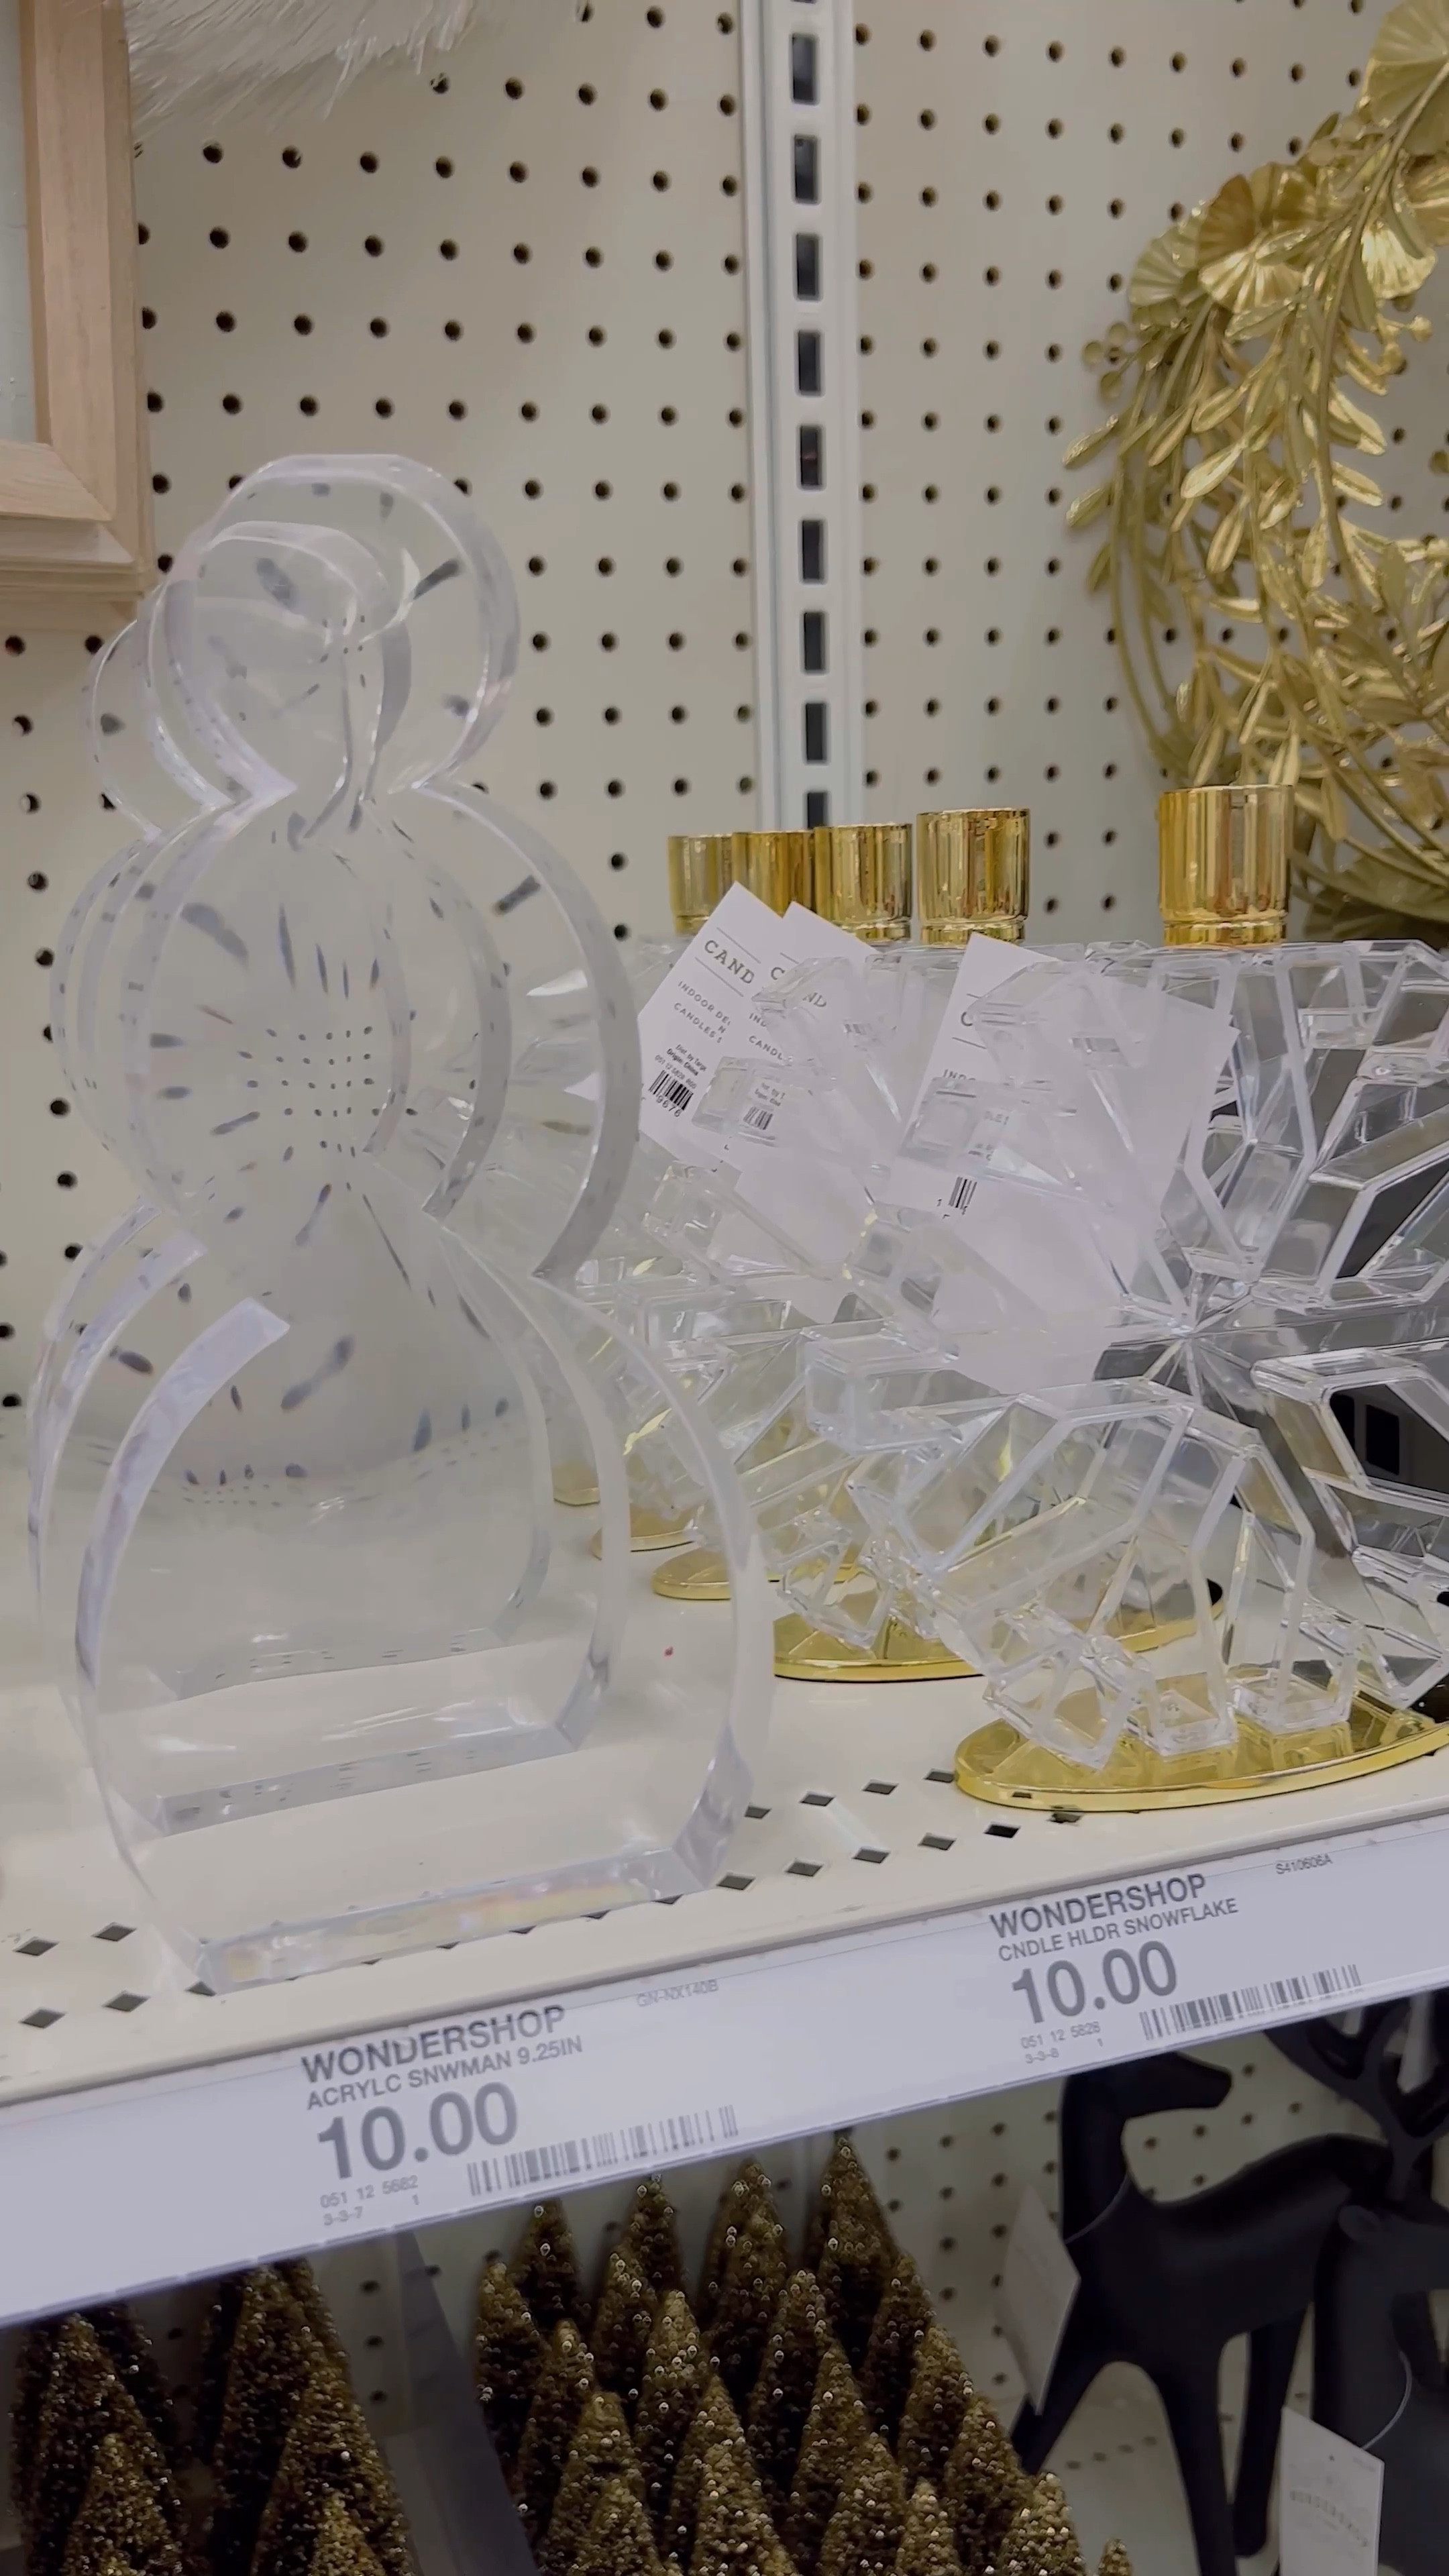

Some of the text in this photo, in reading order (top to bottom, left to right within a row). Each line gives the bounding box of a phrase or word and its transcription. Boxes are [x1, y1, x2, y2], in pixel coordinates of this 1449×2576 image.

[674, 1002, 716, 1038] CANDLES
[678, 981, 714, 1012] INDOOR
[989, 1872, 1206, 1939] WONDERSHOP
[998, 1898, 1240, 1962] CNDLE HLDR SNOWFLAKE
[1012, 1940, 1177, 2024] 10.00
[301, 2004, 566, 2083] WONDERSHOP
[307, 2035, 583, 2110] ACRYLC SNWMAN 9.25IN
[317, 2081, 518, 2180] 10.00
[356, 2184, 376, 2200] 12
